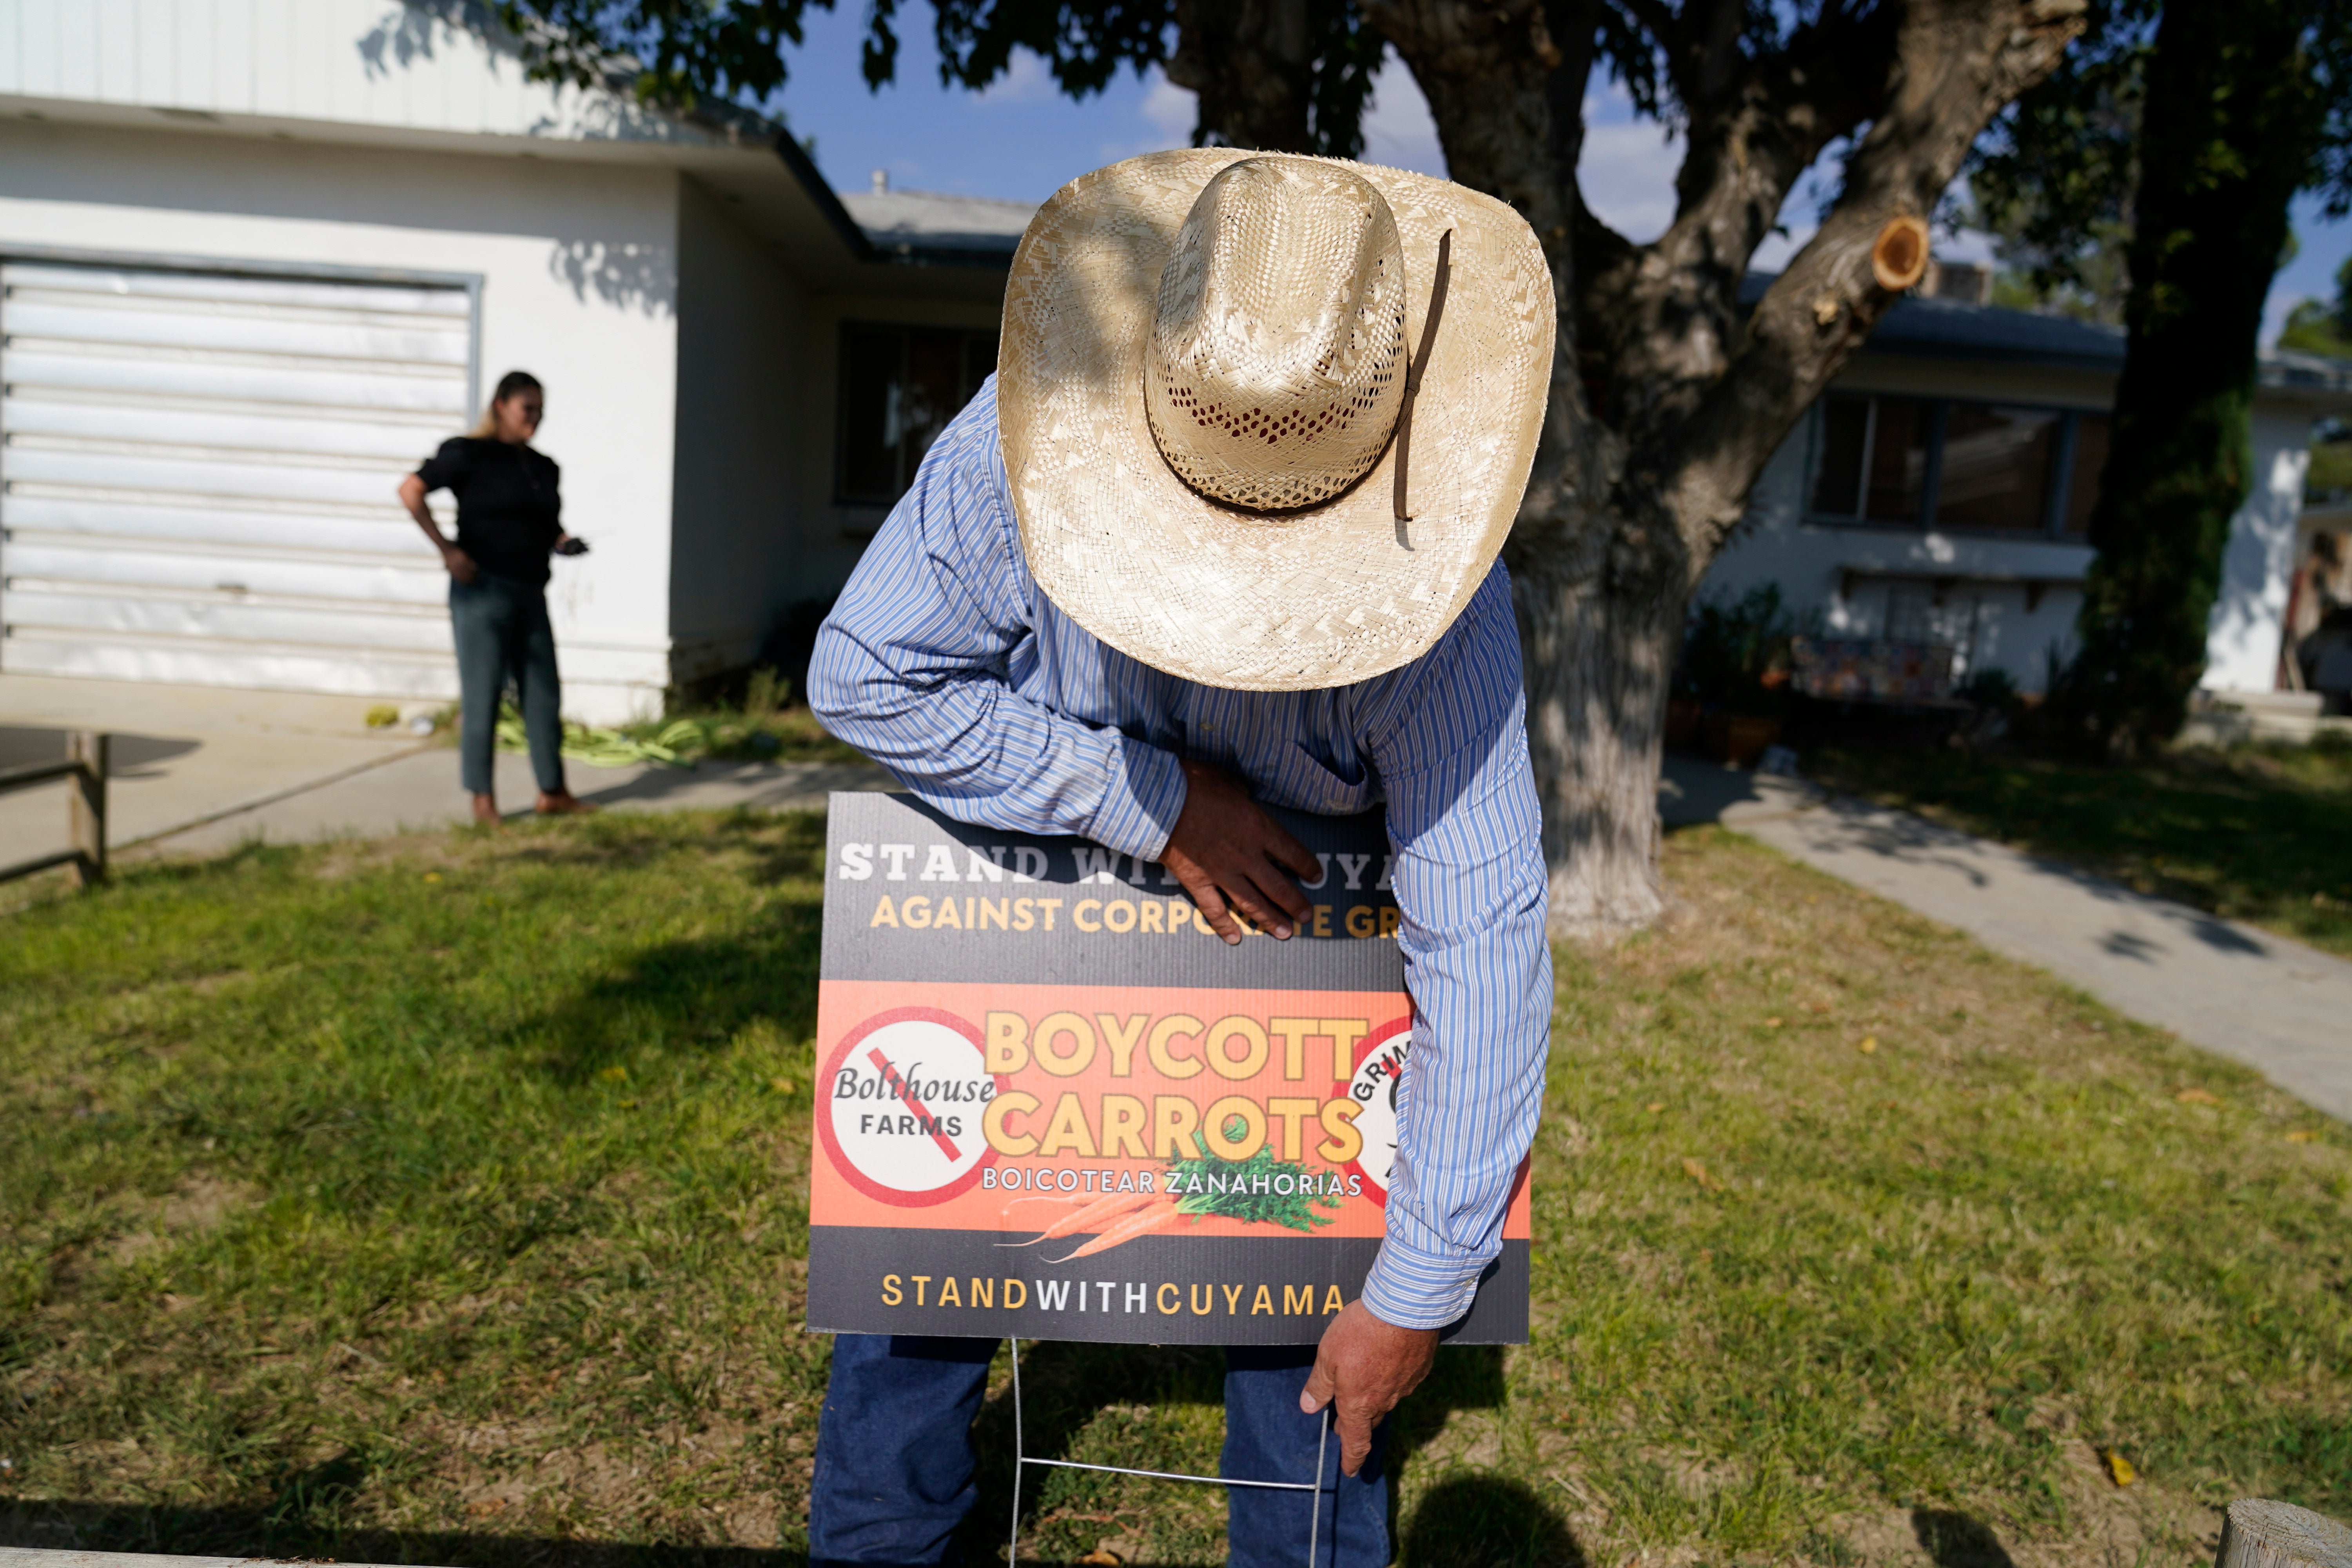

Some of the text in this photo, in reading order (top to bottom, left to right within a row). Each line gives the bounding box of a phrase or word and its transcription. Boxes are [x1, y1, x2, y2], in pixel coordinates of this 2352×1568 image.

[839, 843, 1049, 883] STAND
[870, 894, 1062, 932] AGAINST
[984, 1010, 1369, 1082] BOYCOTT
[834, 1061, 995, 1102] Bolthouse
[860, 1114, 962, 1136] FARMS
[982, 1091, 1365, 1164] CARROTS
[982, 1167, 1362, 1197] BOICOTEAR ZANAHORIAS
